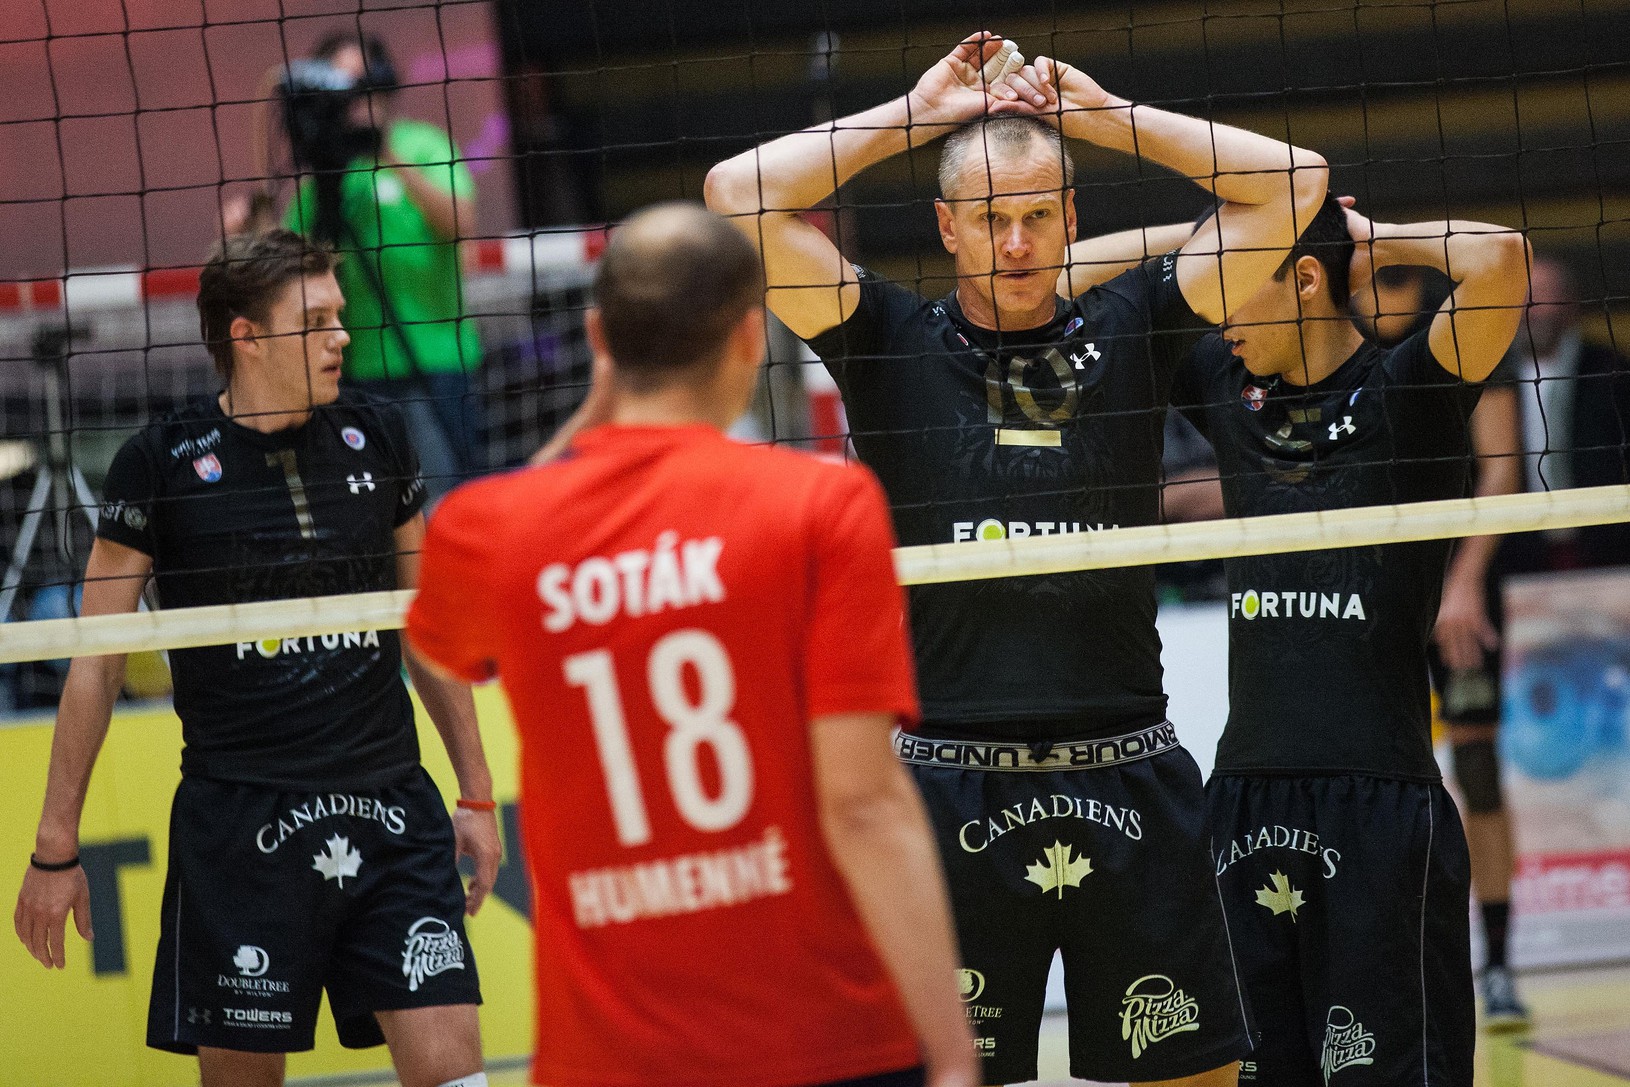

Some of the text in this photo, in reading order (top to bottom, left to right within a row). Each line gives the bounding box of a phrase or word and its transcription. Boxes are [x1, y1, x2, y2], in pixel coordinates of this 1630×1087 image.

[537, 531, 726, 633] SOTÁK
[1231, 590, 1366, 620] FORTUNA
[563, 629, 755, 847] 18
[900, 738, 1019, 768] UNDER
[256, 793, 406, 854] CANADIENS
[959, 794, 1142, 853] CANADIENS
[402, 916, 463, 977] Pizza
[223, 1007, 293, 1022] TOWERS
[1119, 974, 1196, 1041] Pizza
[1132, 1008, 1200, 1060] Mizza
[1320, 1005, 1374, 1069] Pizza
